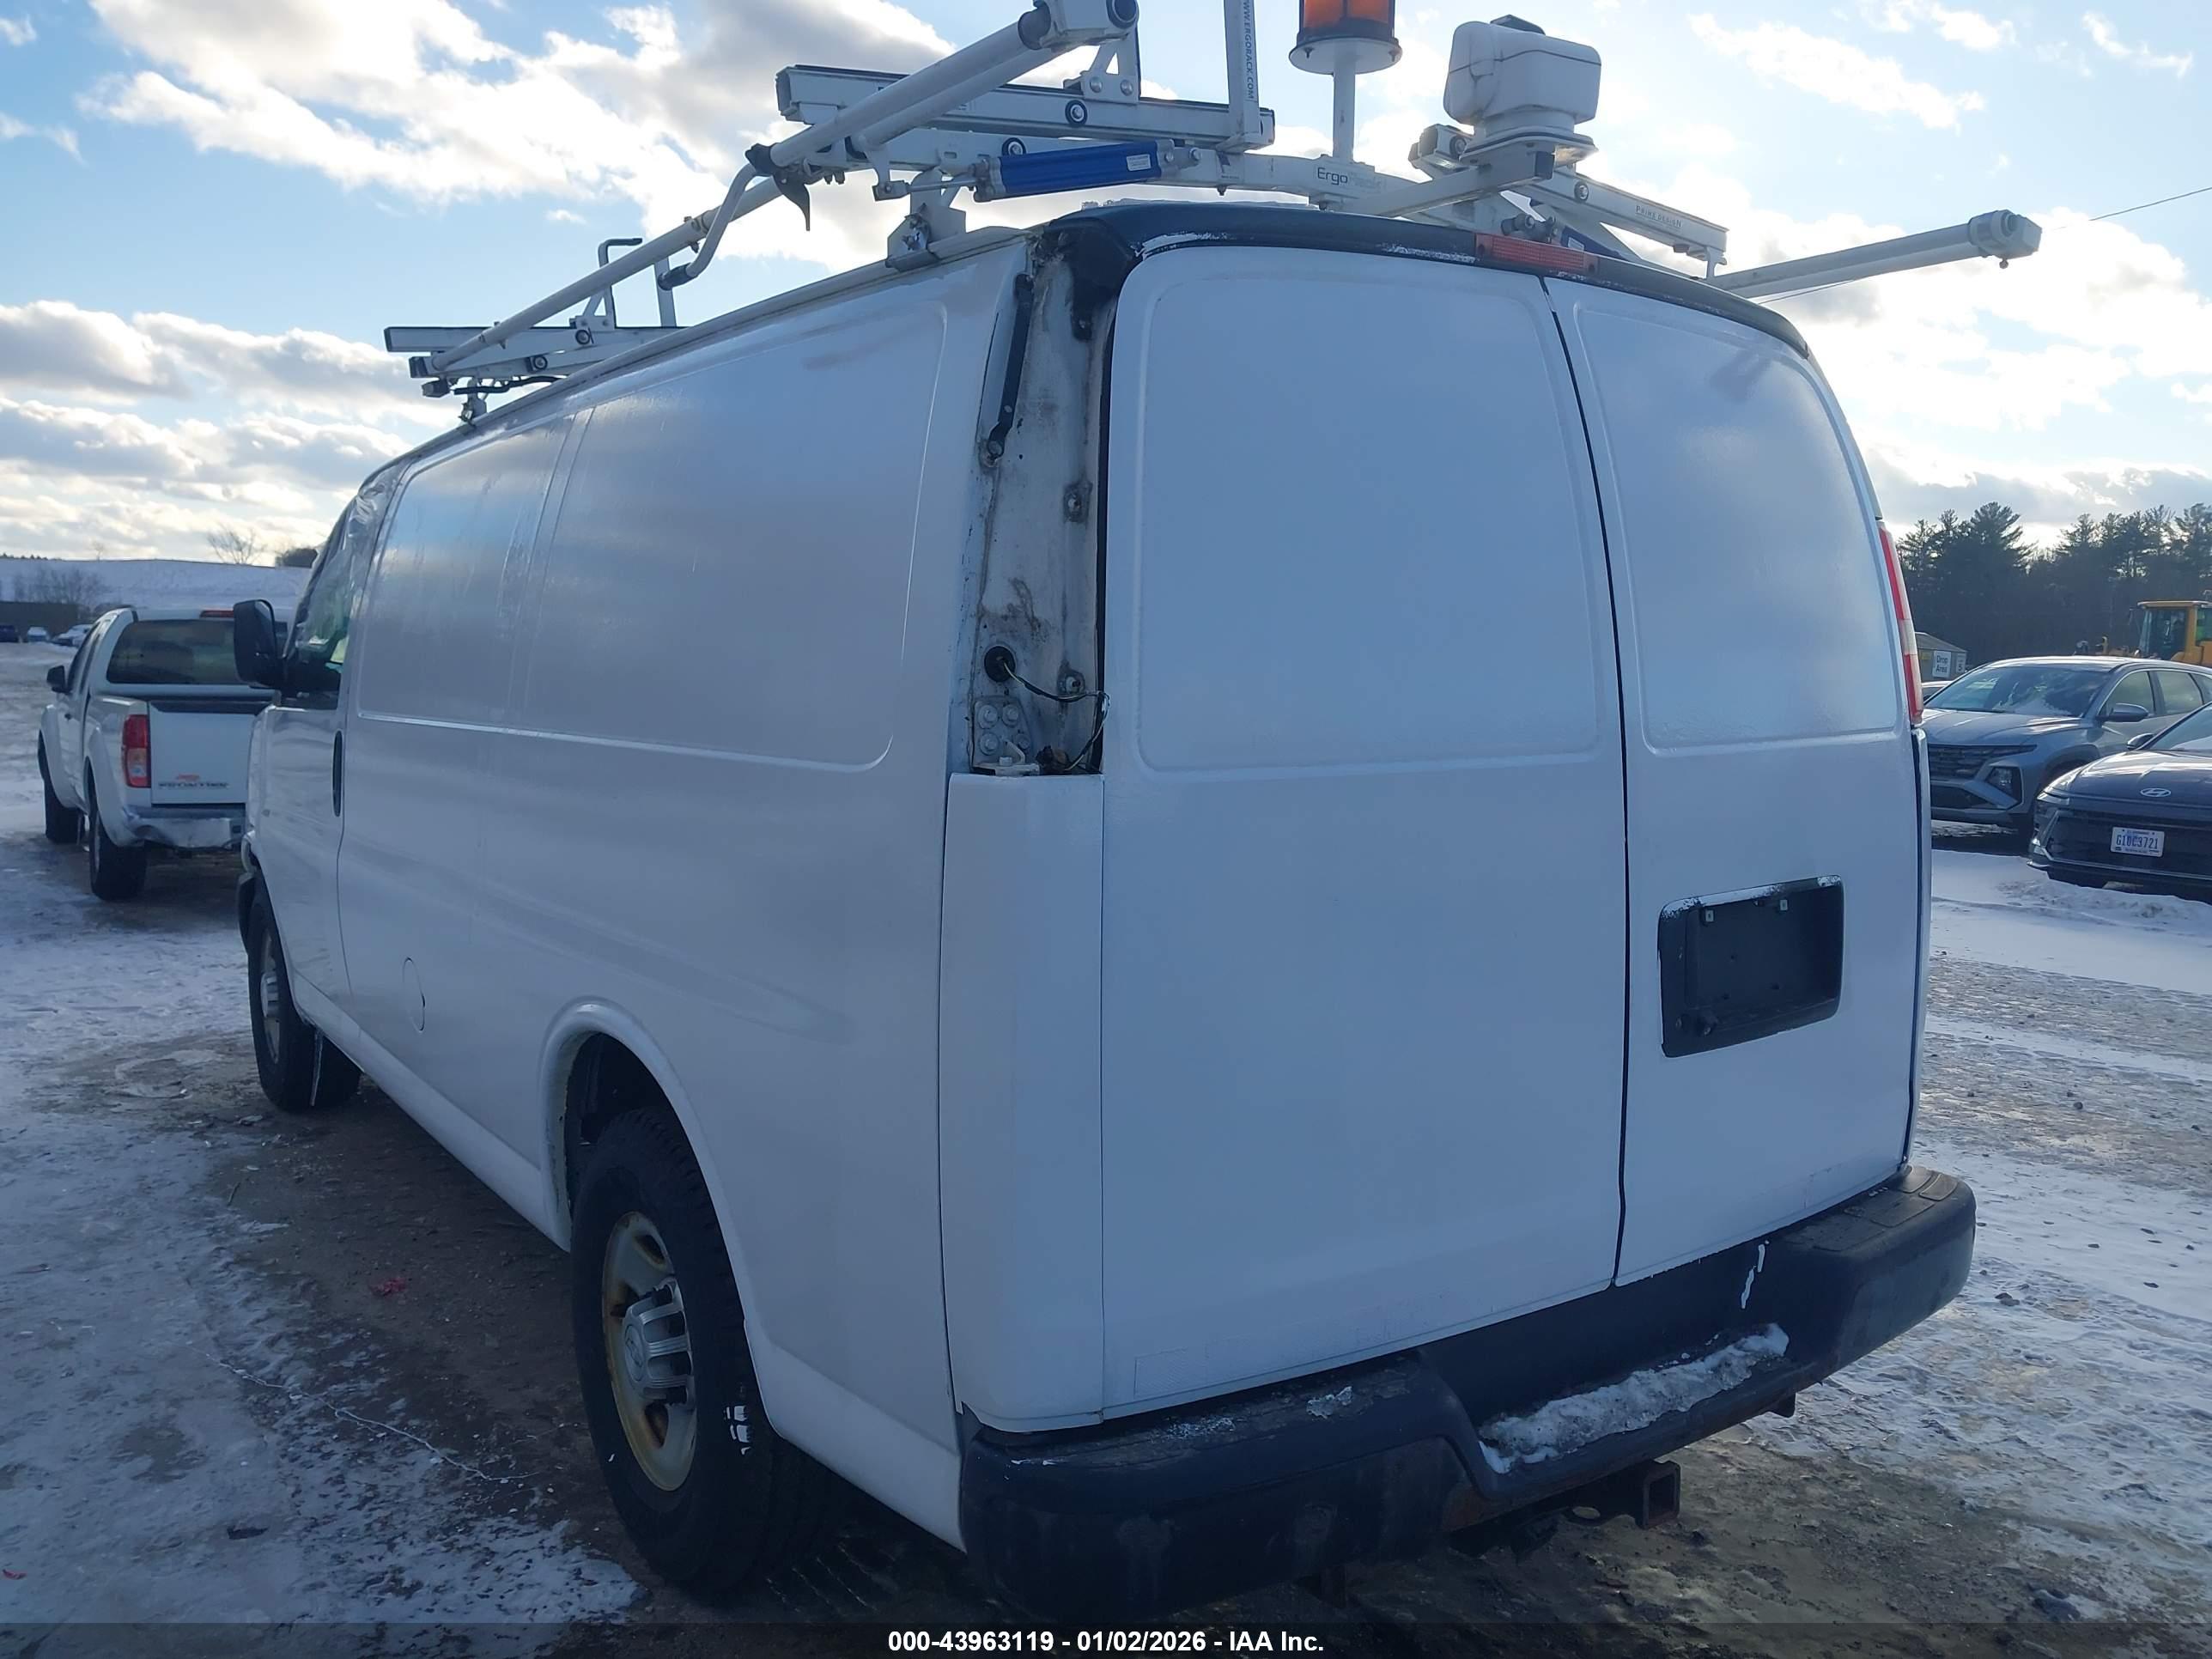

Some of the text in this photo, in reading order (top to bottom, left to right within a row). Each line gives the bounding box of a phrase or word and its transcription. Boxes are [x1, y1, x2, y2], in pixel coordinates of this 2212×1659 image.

[1317, 167, 1348, 185] Ergo
[1936, 655, 1948, 664] Drop
[1936, 664, 1948, 673] Area
